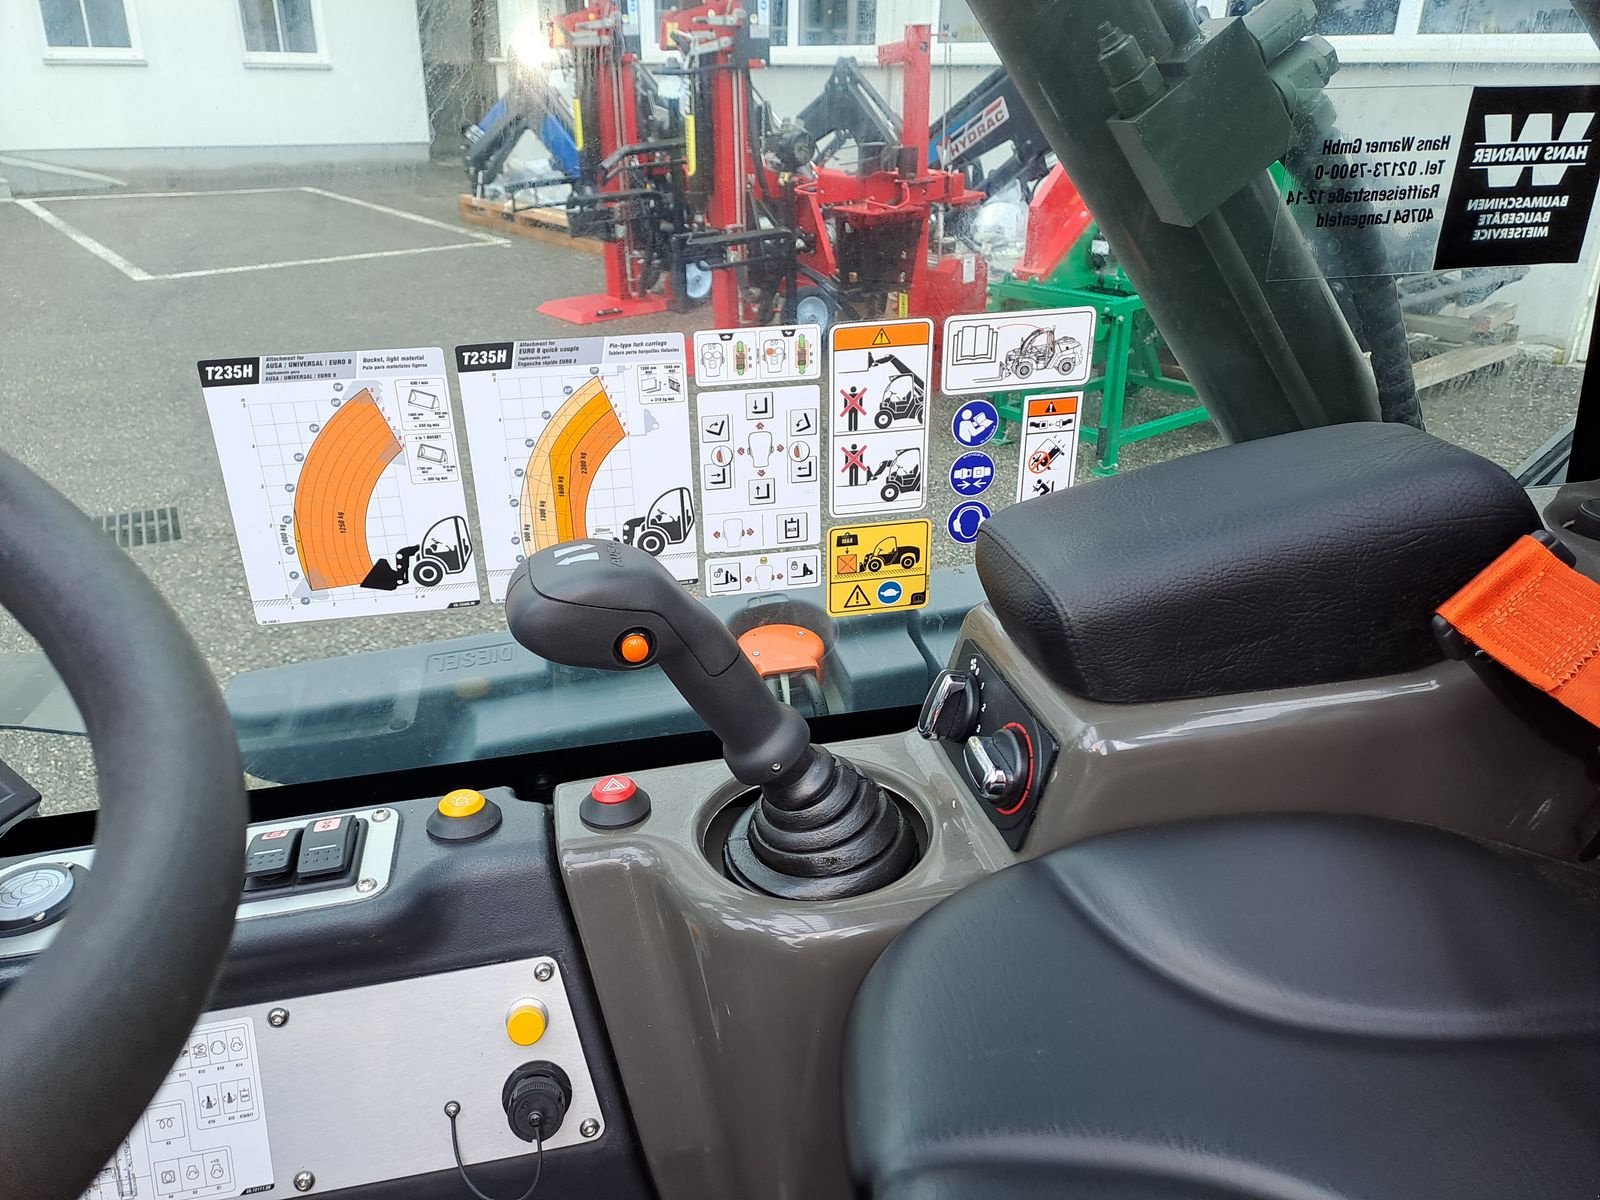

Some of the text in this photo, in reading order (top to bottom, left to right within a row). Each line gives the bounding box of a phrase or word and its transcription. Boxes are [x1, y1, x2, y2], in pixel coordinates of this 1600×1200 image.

[950, 110, 1005, 158] HYDRAC
[462, 349, 507, 365] T235H
[205, 364, 253, 380] T235H
[434, 646, 513, 672] DIESEL
[981, 703, 986, 712] 2
